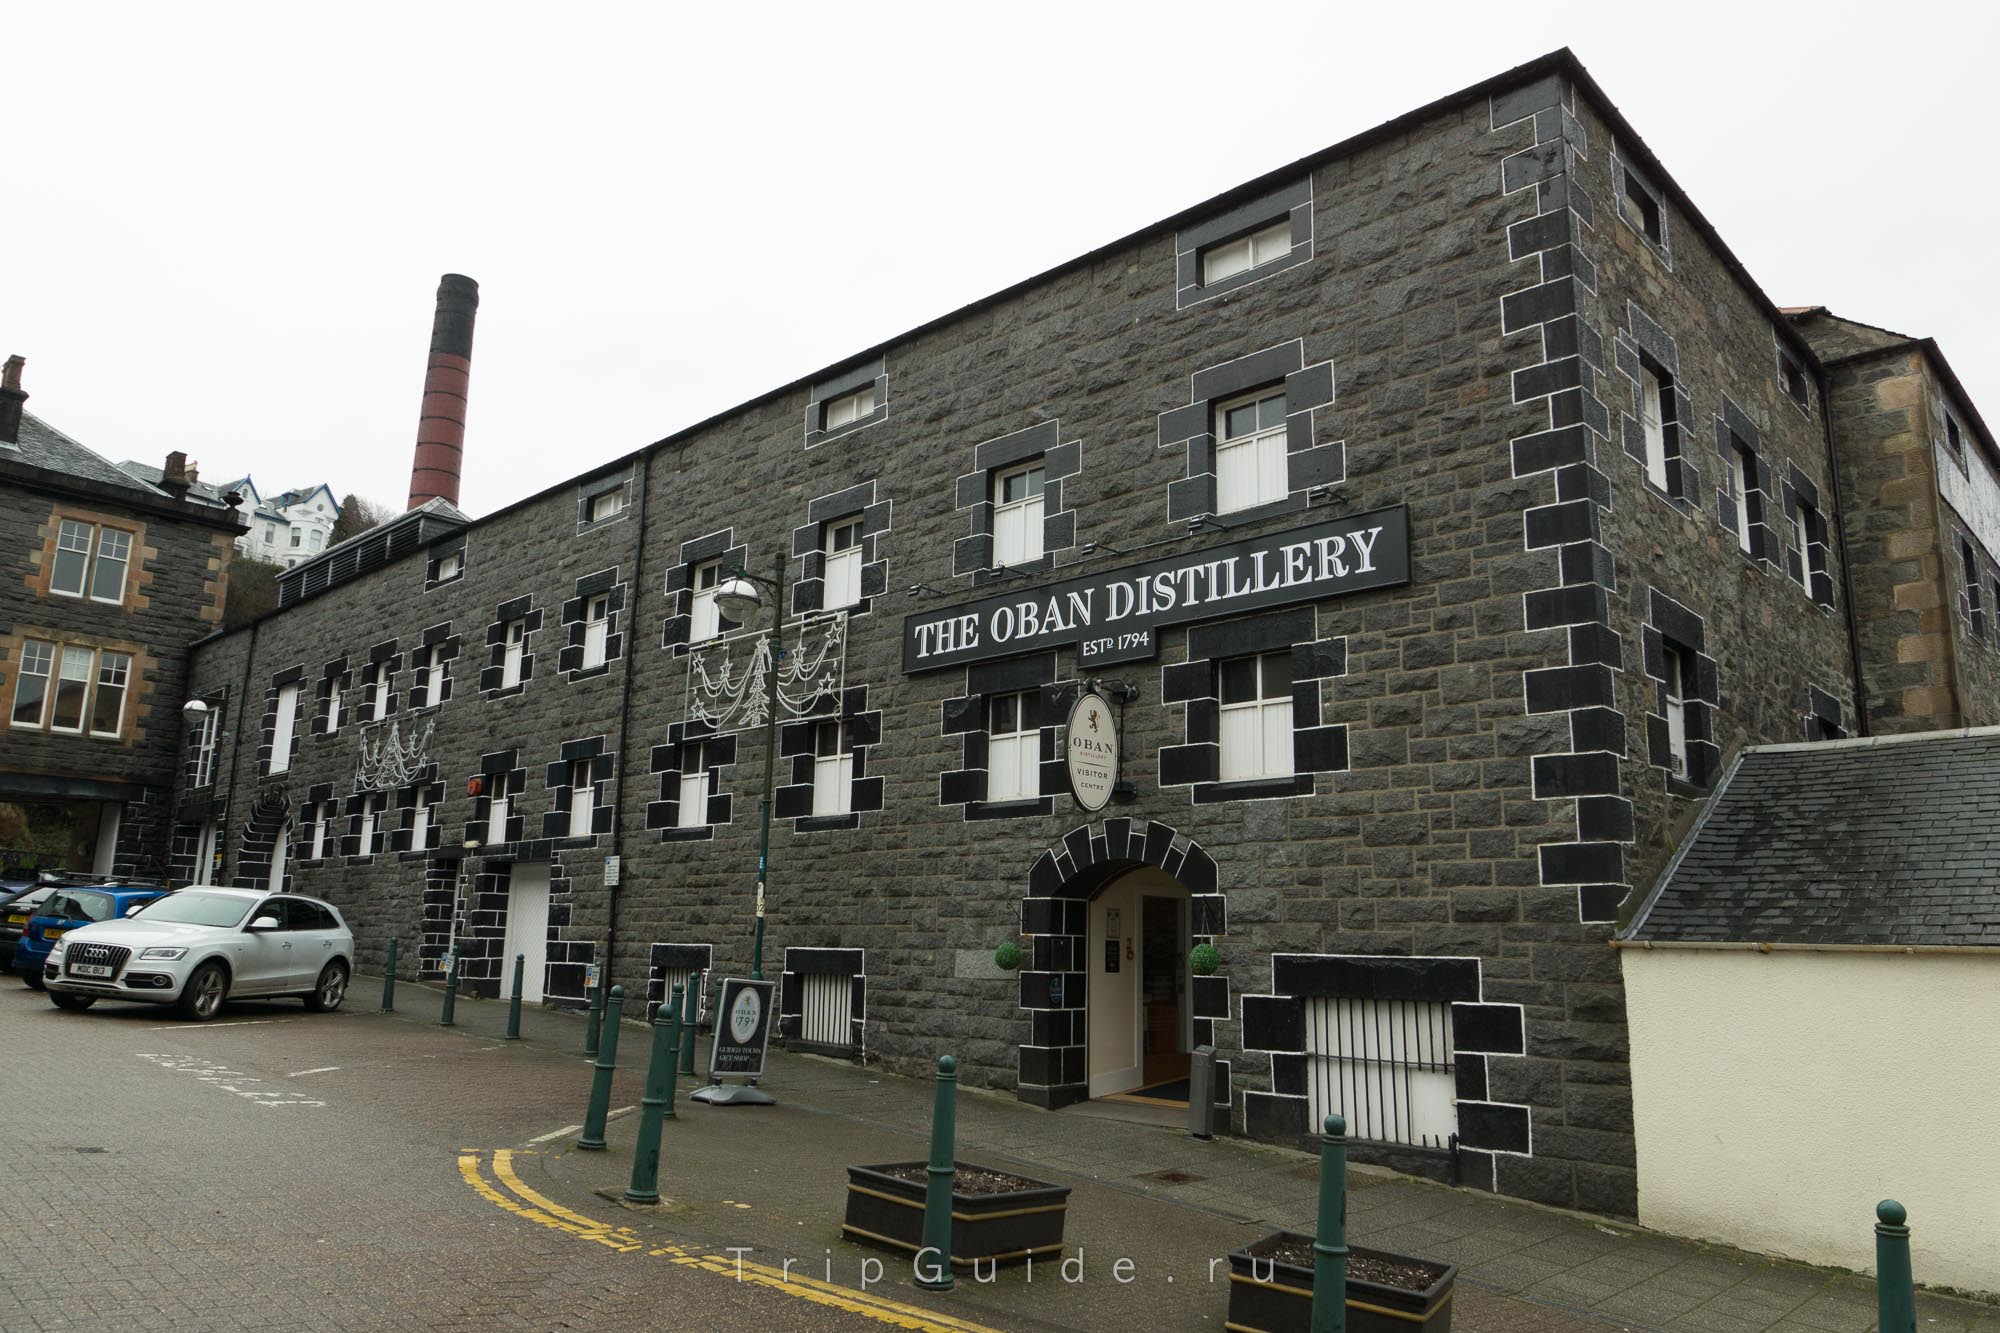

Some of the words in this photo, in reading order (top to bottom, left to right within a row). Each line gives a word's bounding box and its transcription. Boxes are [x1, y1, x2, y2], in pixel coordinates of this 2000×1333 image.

[914, 613, 980, 659] THE
[990, 588, 1095, 643] OBAN
[1105, 526, 1384, 622] DISTILLERY
[1118, 631, 1149, 650] 1794
[1073, 737, 1113, 754] OBAN
[1077, 768, 1108, 780] VISITOR
[1081, 782, 1104, 791] CENTRE
[735, 1016, 755, 1027] 1794
